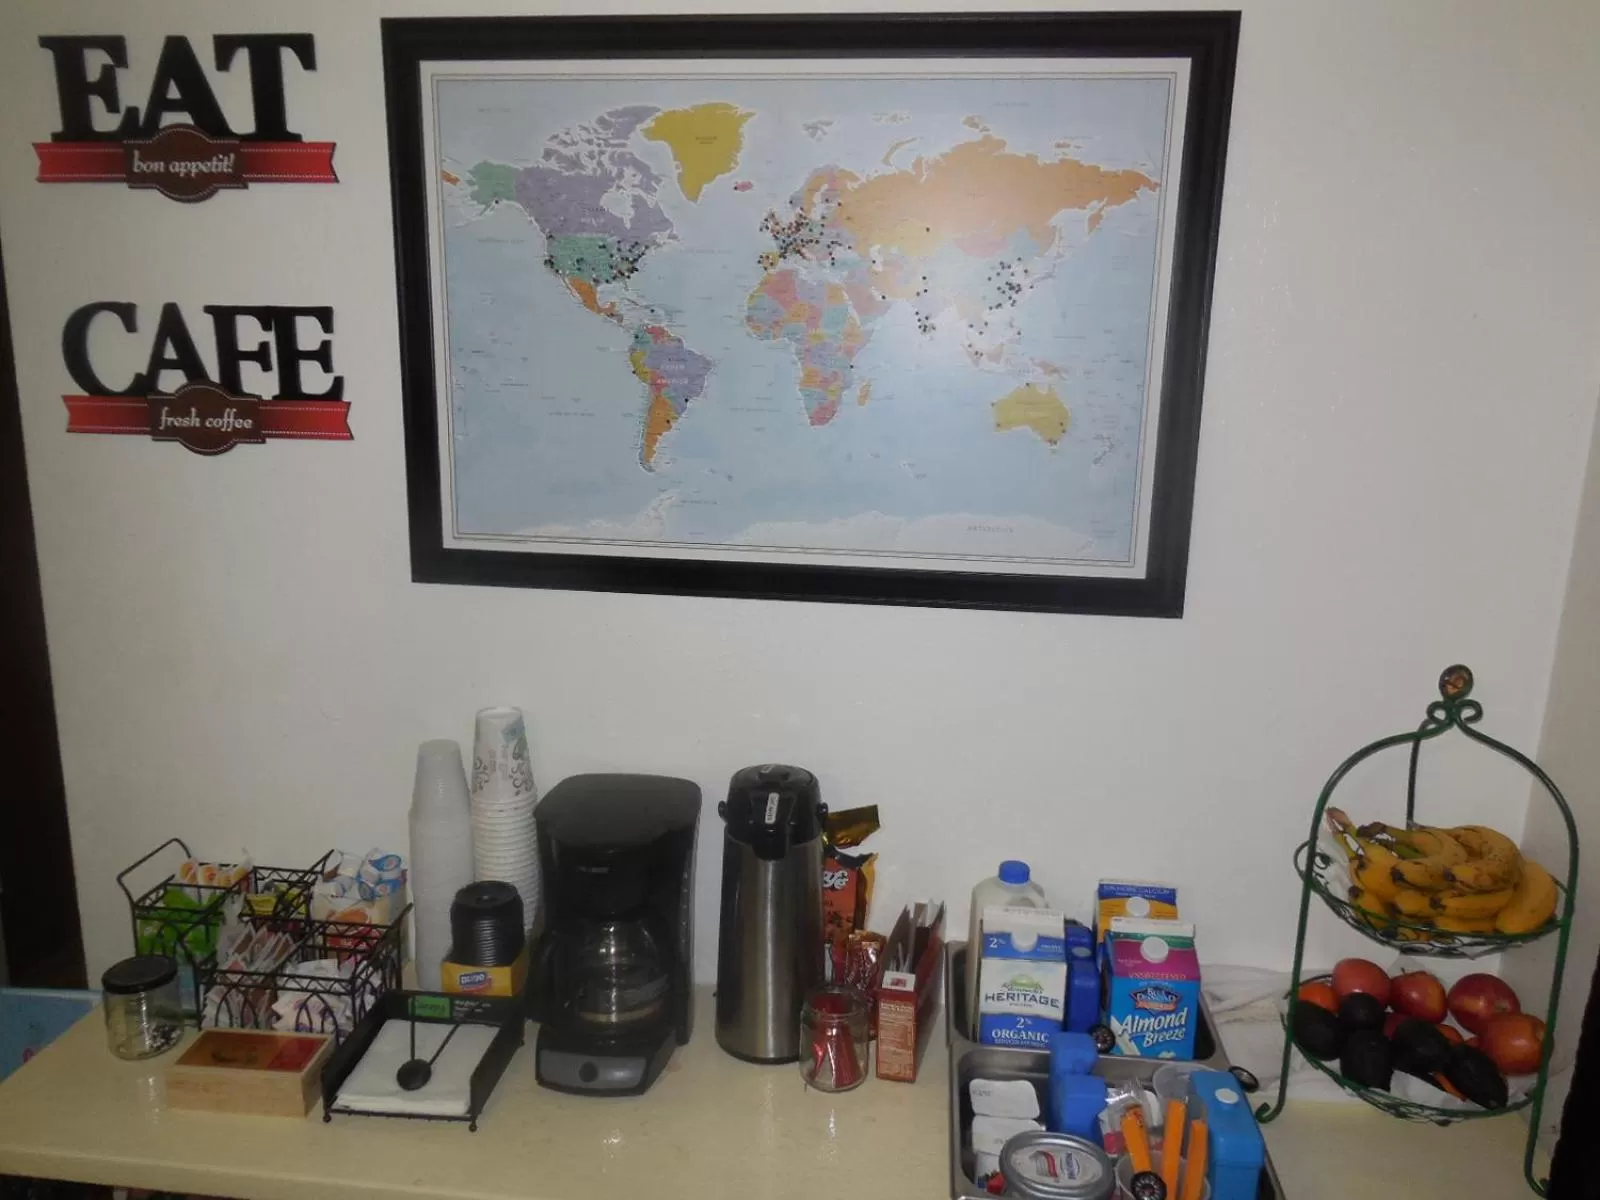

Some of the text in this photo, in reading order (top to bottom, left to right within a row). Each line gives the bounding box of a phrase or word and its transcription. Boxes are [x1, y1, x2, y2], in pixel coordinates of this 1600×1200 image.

[38, 33, 317, 142] EAT
[133, 150, 236, 178] bon appetit!
[62, 301, 344, 401] CAFE
[159, 406, 253, 431] fresh coffee
[984, 991, 1060, 1009] HERITAGE
[1118, 1006, 1188, 1036] Almond
[991, 1028, 1050, 1043] ORGANIC
[1143, 1028, 1186, 1048] Breeze
